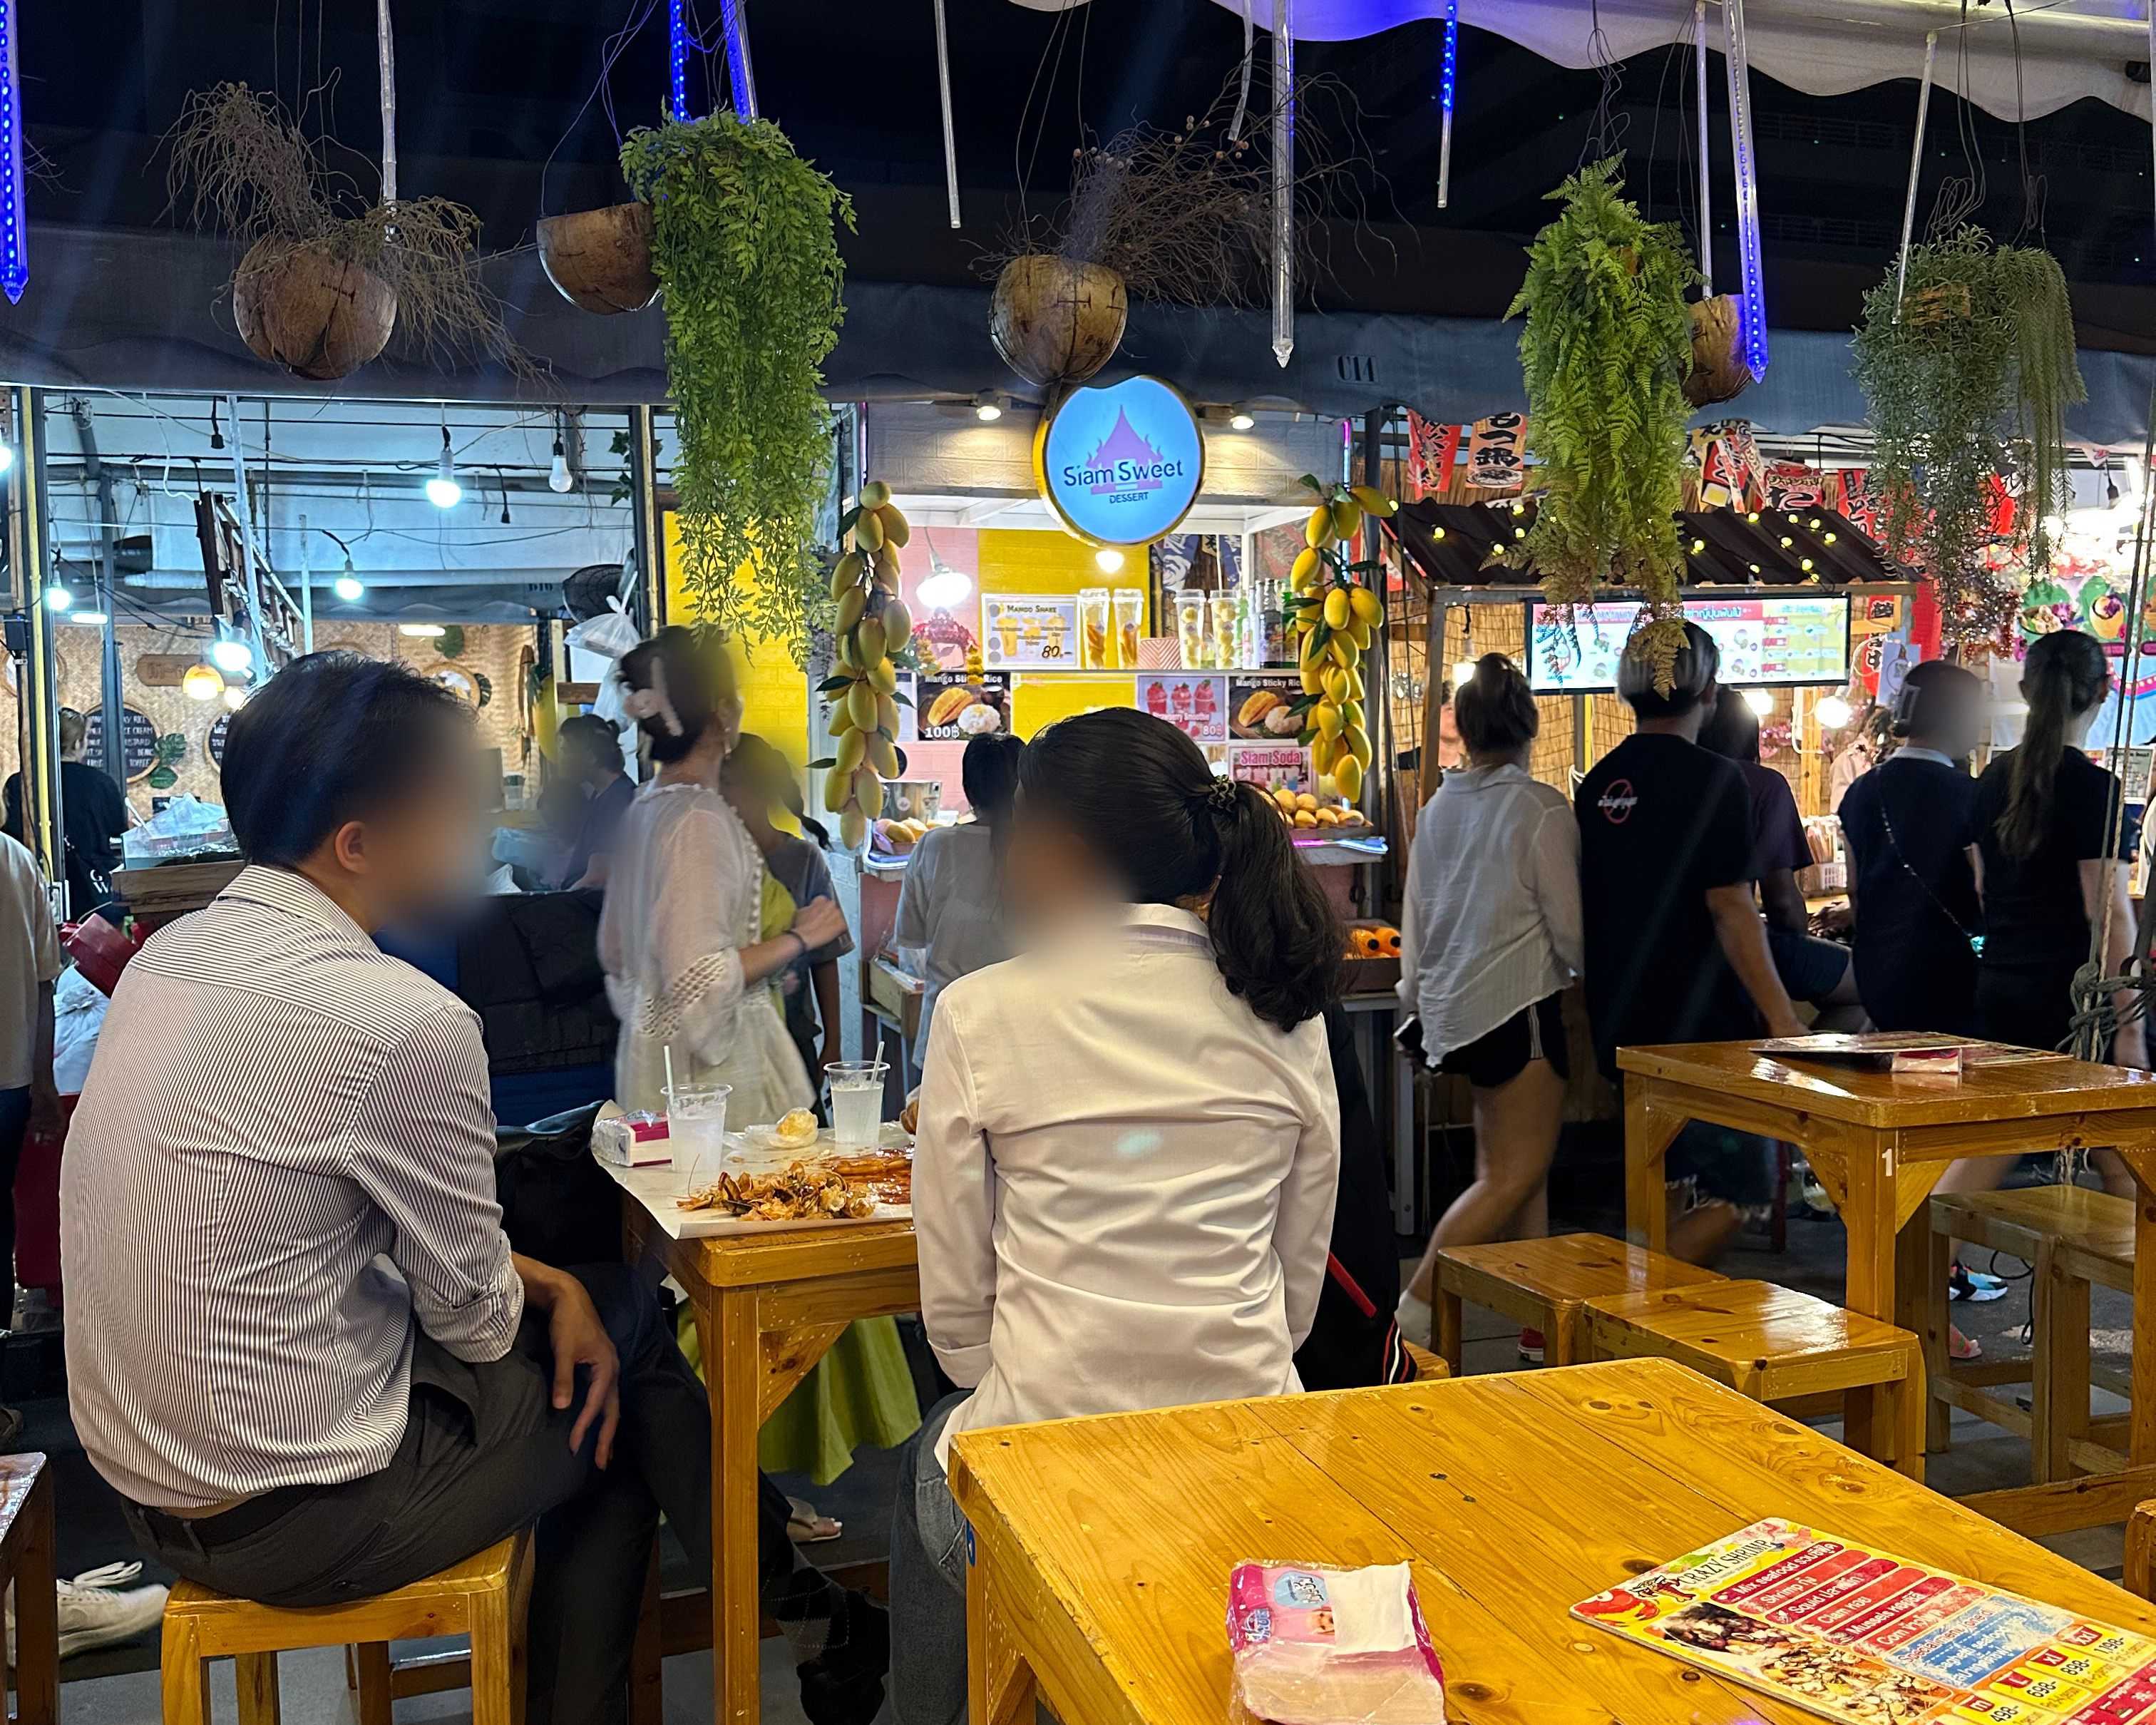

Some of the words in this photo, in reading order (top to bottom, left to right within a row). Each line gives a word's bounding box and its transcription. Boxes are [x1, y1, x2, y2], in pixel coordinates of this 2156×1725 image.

[1063, 464, 1114, 486] Siam
[1118, 459, 1184, 481] Sweet
[1109, 491, 1149, 504] DESSERT
[925, 675, 953, 685] Mango
[983, 675, 1002, 683] Rice
[1236, 678, 1261, 688] Mango
[1263, 678, 1288, 687] Sticky
[1288, 678, 1301, 687] Ric
[1241, 750, 1268, 765] Siam
[1272, 749, 1301, 764] Soda
[1678, 1557, 1729, 1585] CRAZY
[1720, 1539, 1772, 1565] SHRIMP
[1732, 1581, 1760, 1595] Mix
[1755, 1562, 1796, 1585] seafood
[1760, 1582, 1804, 1604] Shrimp
[1795, 1575, 1818, 1587] กุ้ง
[1788, 1595, 1822, 1614] Squid
[1817, 1607, 1849, 1624] Clam
[1847, 1595, 1872, 1610] หอย
[1845, 1608, 1895, 1635] Mussels
[1876, 1627, 1907, 1646] Corn
[1897, 1636, 1939, 1664] Special
